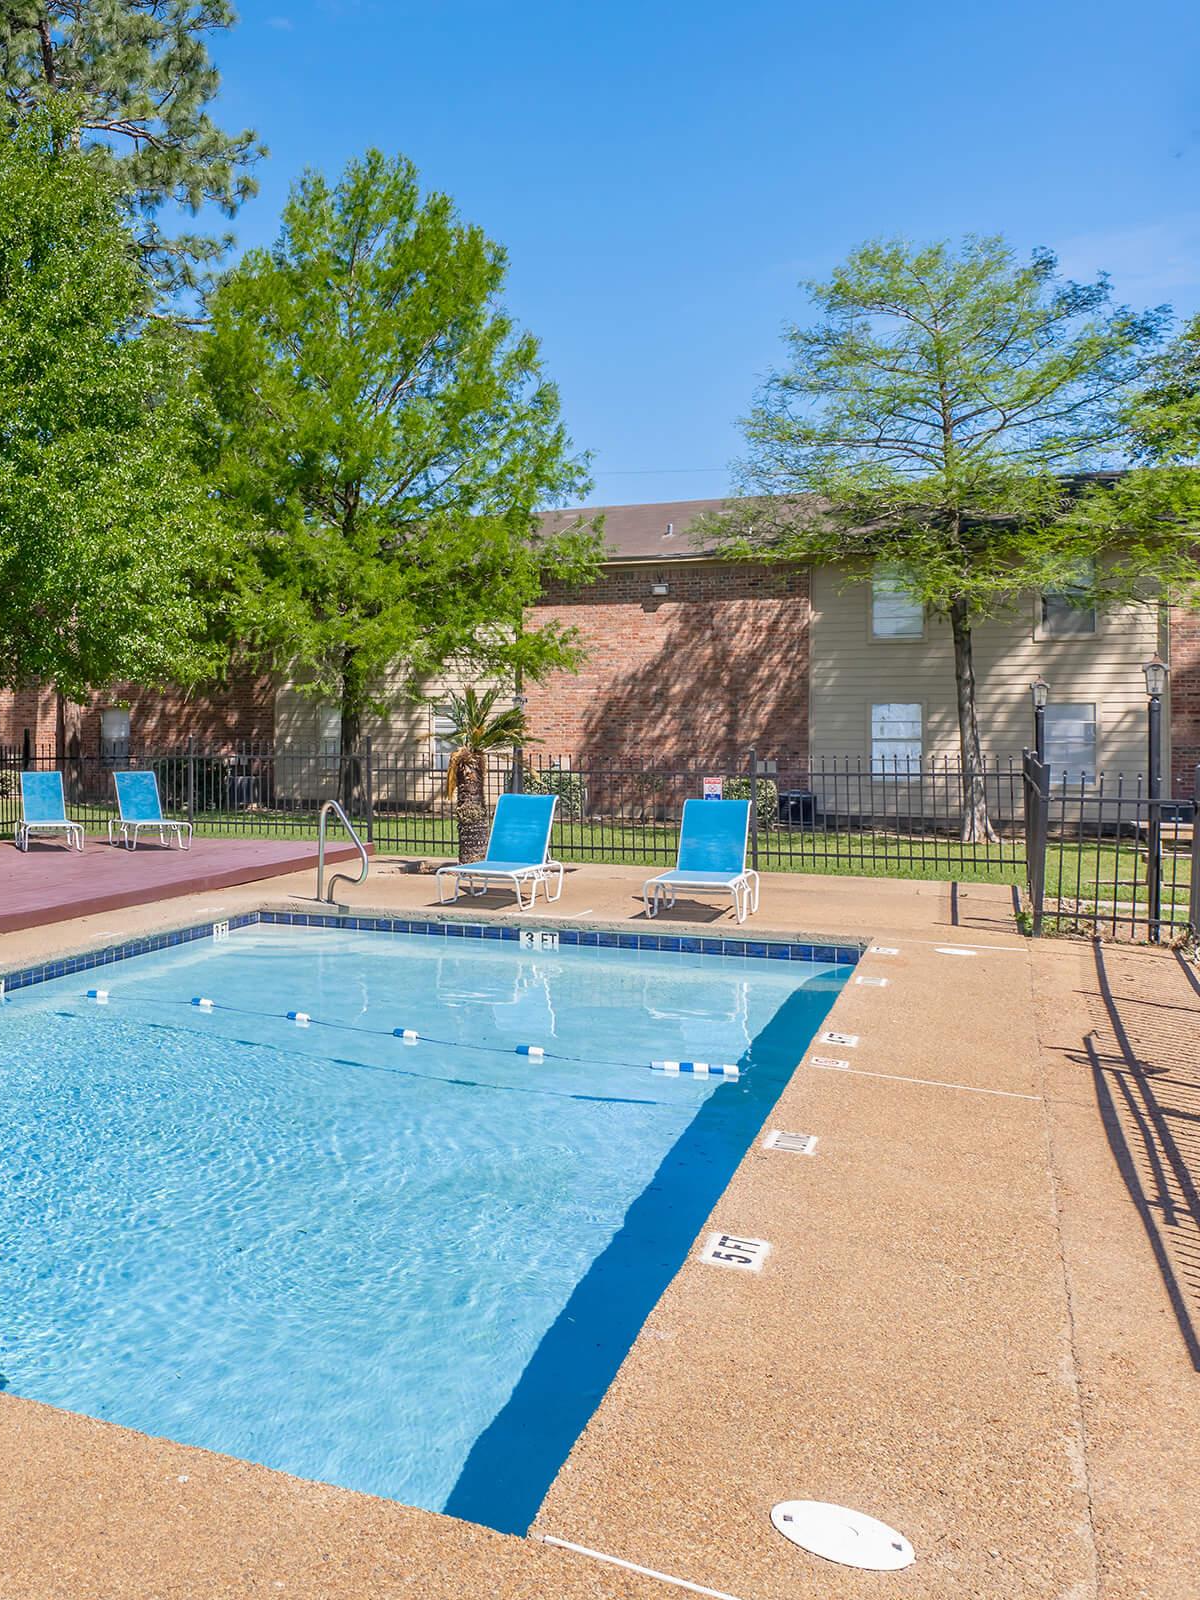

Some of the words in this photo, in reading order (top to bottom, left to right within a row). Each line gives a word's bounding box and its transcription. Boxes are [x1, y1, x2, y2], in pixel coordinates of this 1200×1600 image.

[525, 932, 534, 942] 3
[541, 933, 558, 944] FT
[718, 1236, 760, 1254] FT
[712, 1251, 752, 1264] 5
